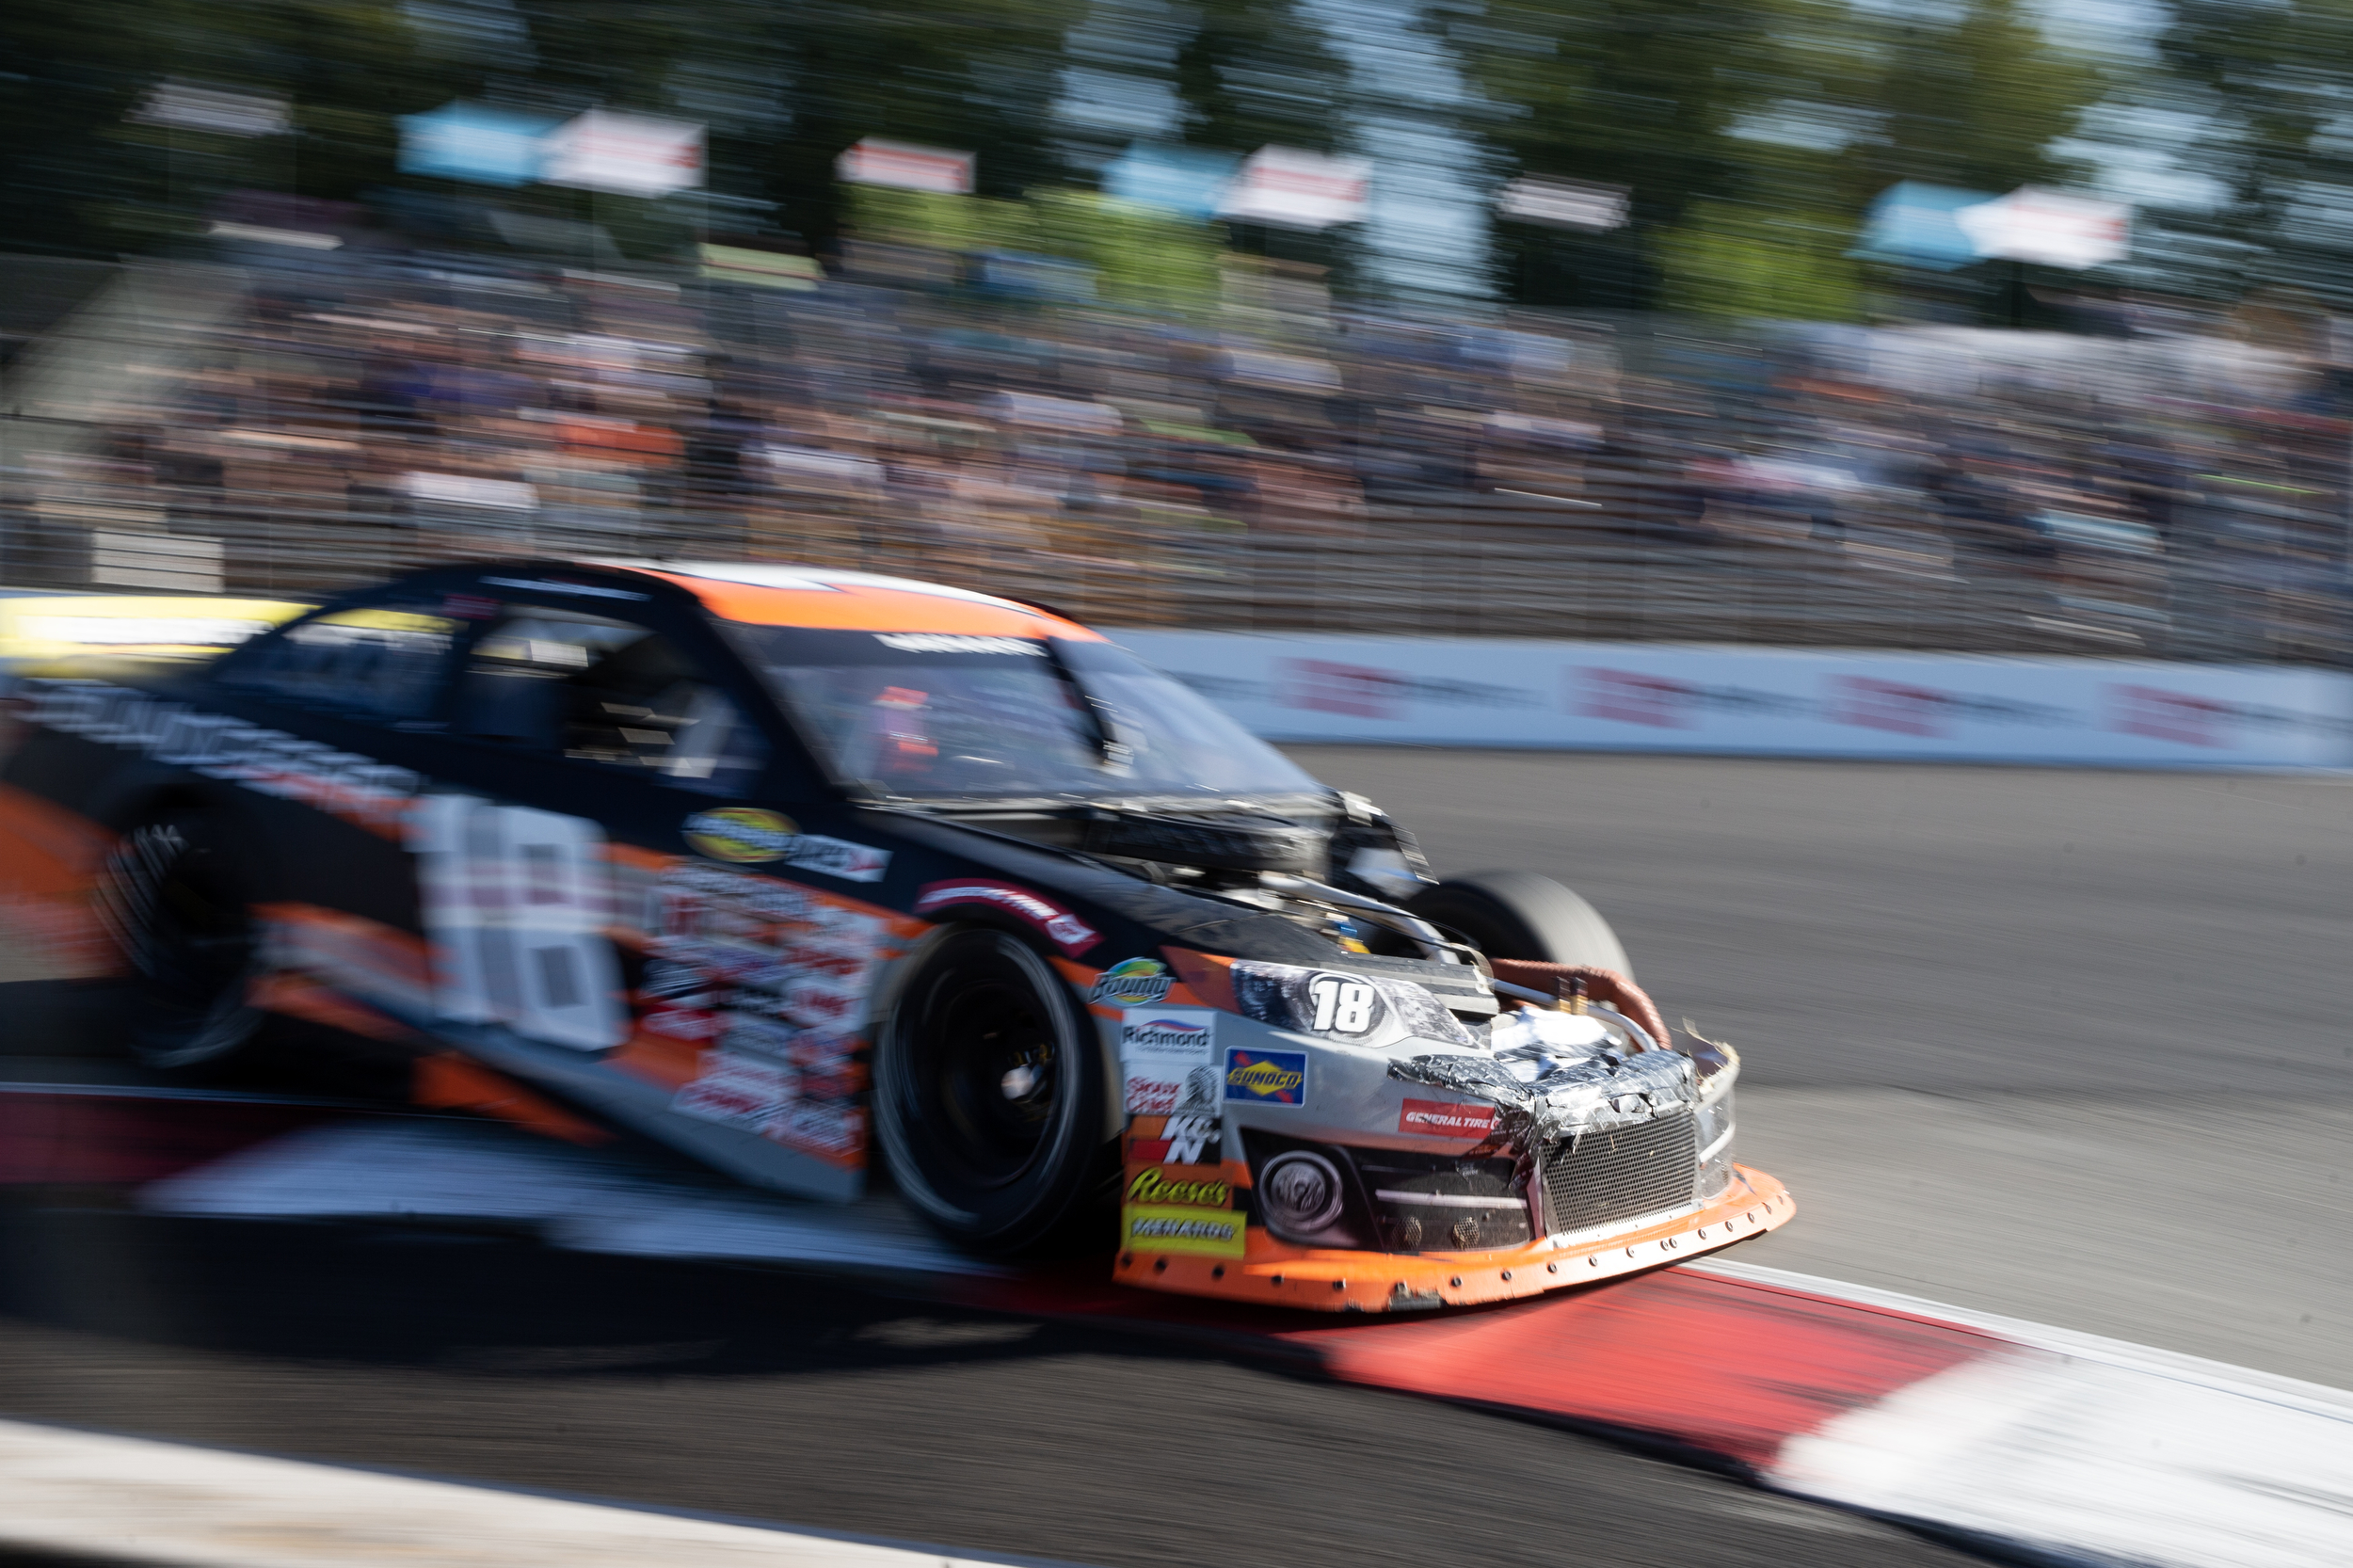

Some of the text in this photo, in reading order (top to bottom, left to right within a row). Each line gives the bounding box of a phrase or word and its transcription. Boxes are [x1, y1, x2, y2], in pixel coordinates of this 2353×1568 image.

[1313, 980, 1375, 1033] 18
[1123, 1026, 1210, 1048] Richmond
[1227, 1068, 1303, 1089] SUNOCO
[1405, 1111, 1491, 1130] GENERAL TIRE
[1127, 1167, 1229, 1207] Reese's
[1131, 1217, 1235, 1241] MENARDS
